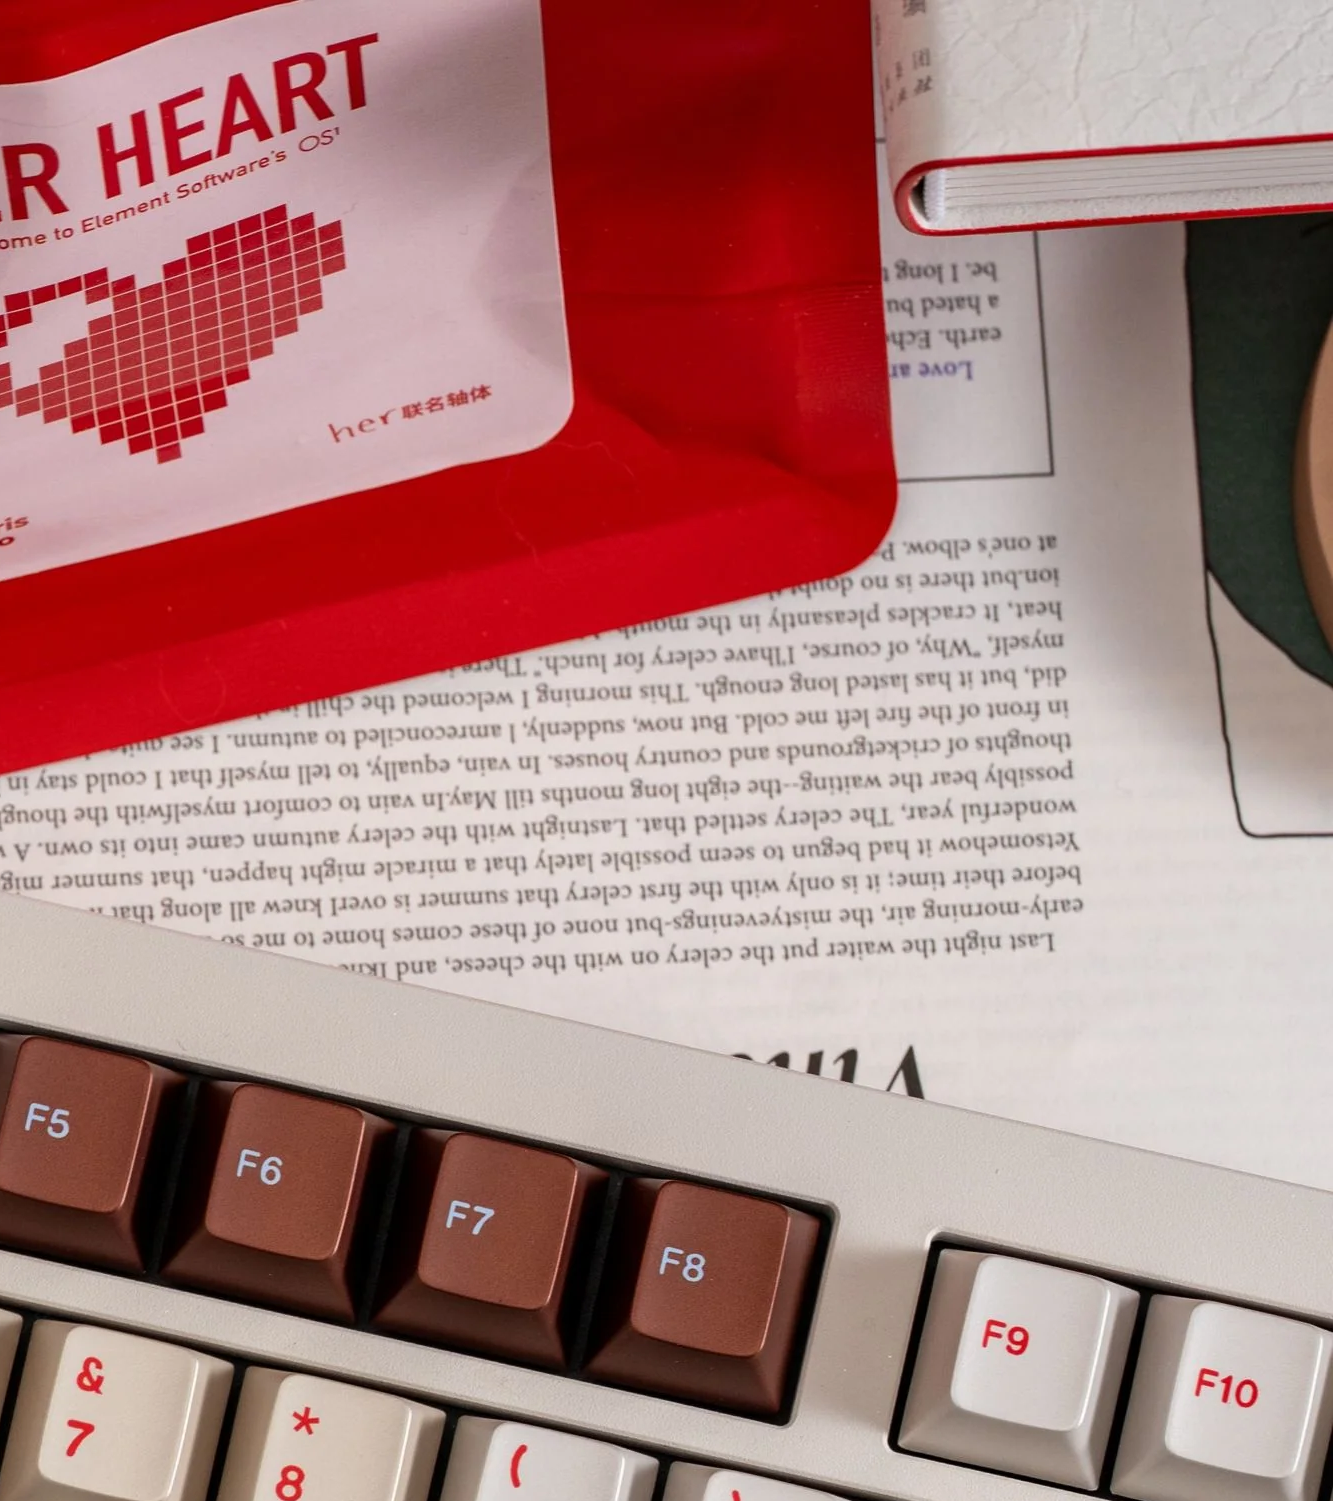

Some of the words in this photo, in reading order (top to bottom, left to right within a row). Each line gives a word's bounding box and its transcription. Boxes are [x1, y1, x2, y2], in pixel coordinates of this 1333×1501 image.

[96, 32, 380, 200] HEART
[53, 225, 75, 239] to
[81, 191, 171, 233] Element
[176, 150, 287, 199] Software's
[895, 260, 943, 283] long
[951, 264, 958, 282] I
[966, 262, 997, 282] be.
[921, 296, 981, 317] hated
[988, 295, 999, 308] a
[939, 327, 1002, 349] earth.
[919, 361, 973, 381] Love
[327, 407, 397, 444] her
[400, 383, 493, 421] 联名轴体
[783, 938, 818, 960] put
[827, 941, 895, 960] waiter
[902, 938, 936, 959] the
[945, 930, 1001, 957] night
[1010, 933, 1055, 952] Last
[445, 956, 524, 977] cheese,
[532, 955, 566, 975] the
[575, 953, 623, 974] with
[631, 951, 659, 965] on
[667, 944, 732, 968] celery
[741, 946, 774, 966] the
[396, 960, 436, 982] and
[25, 1103, 69, 1138] F5
[237, 1149, 282, 1184] F6
[447, 1201, 494, 1234] F7
[660, 1247, 705, 1281] F8
[982, 1319, 1029, 1355] F9
[76, 1357, 104, 1394] &
[1195, 1368, 1259, 1408] F10
[66, 1420, 94, 1456] 7
[510, 1445, 527, 1488] (
